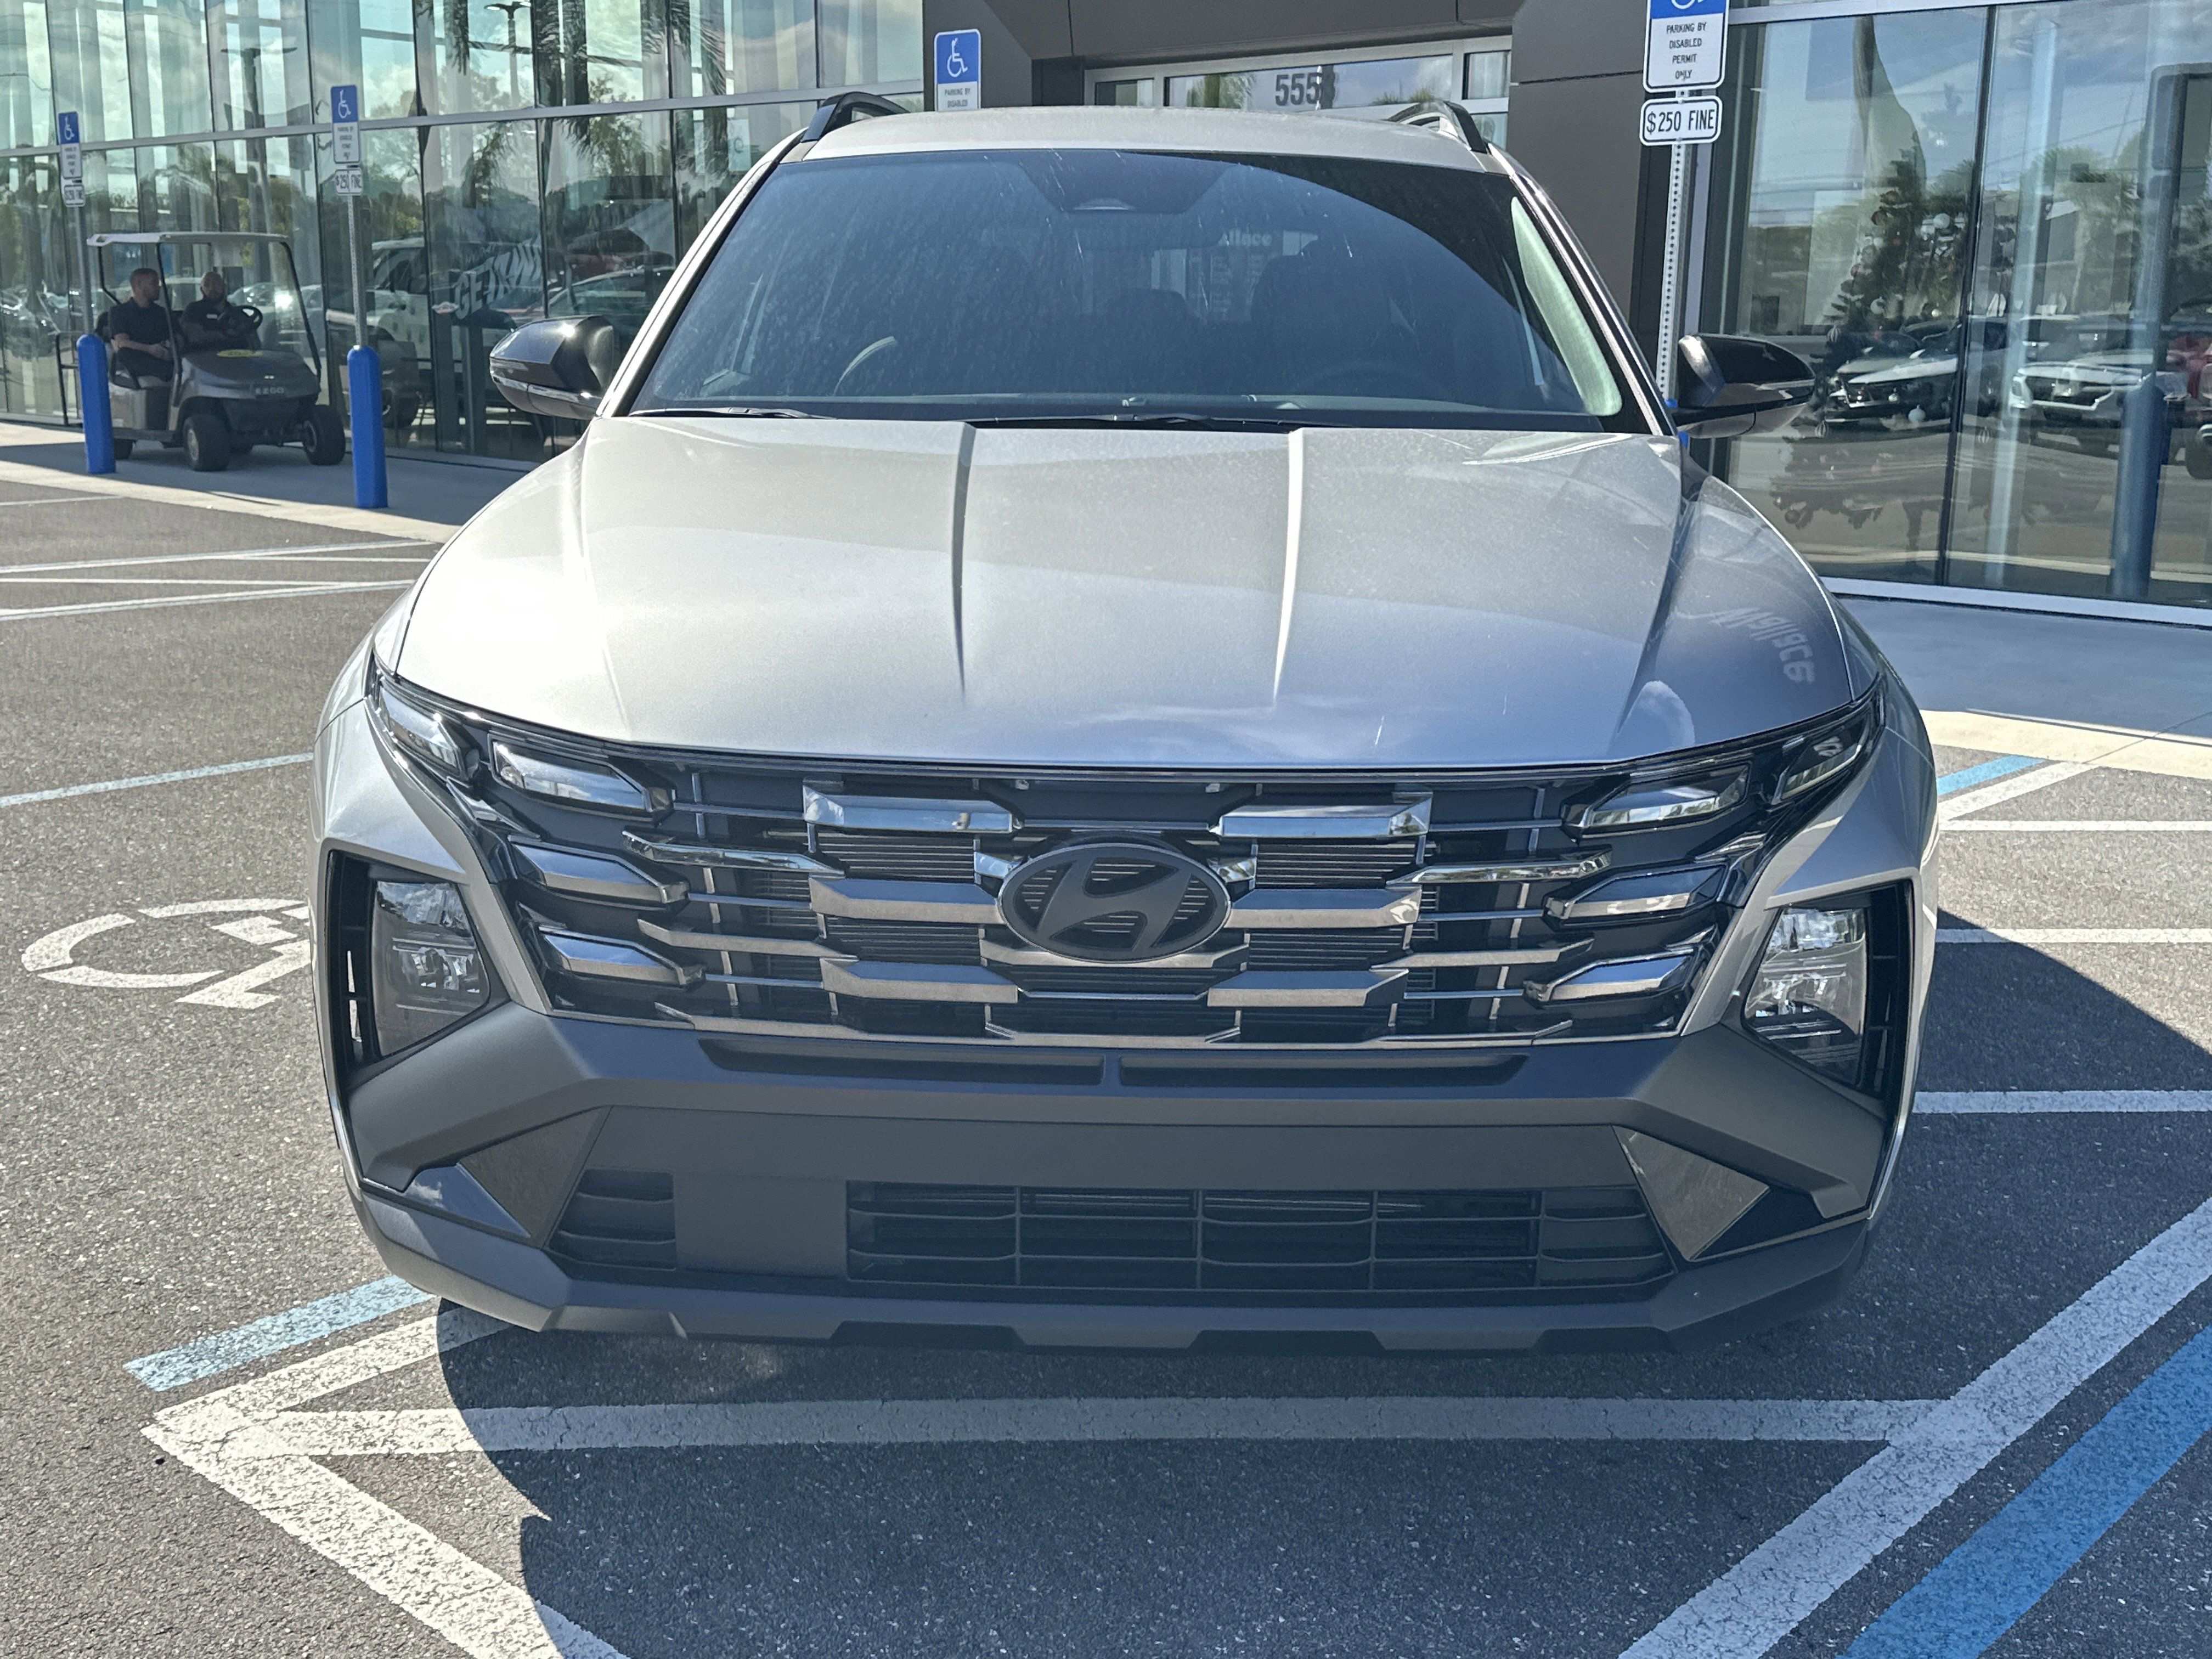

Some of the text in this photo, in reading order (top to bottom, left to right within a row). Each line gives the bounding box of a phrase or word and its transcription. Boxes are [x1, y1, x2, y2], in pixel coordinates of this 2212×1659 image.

[1666, 22, 1707, 34] PARKING BY
[1669, 38, 1702, 49] DISABLED
[1672, 54, 1697, 64] PERMIT
[1675, 70, 1692, 80] ONLY
[1275, 72, 1323, 106] 555
[1646, 109, 1715, 134] $250 FINE
